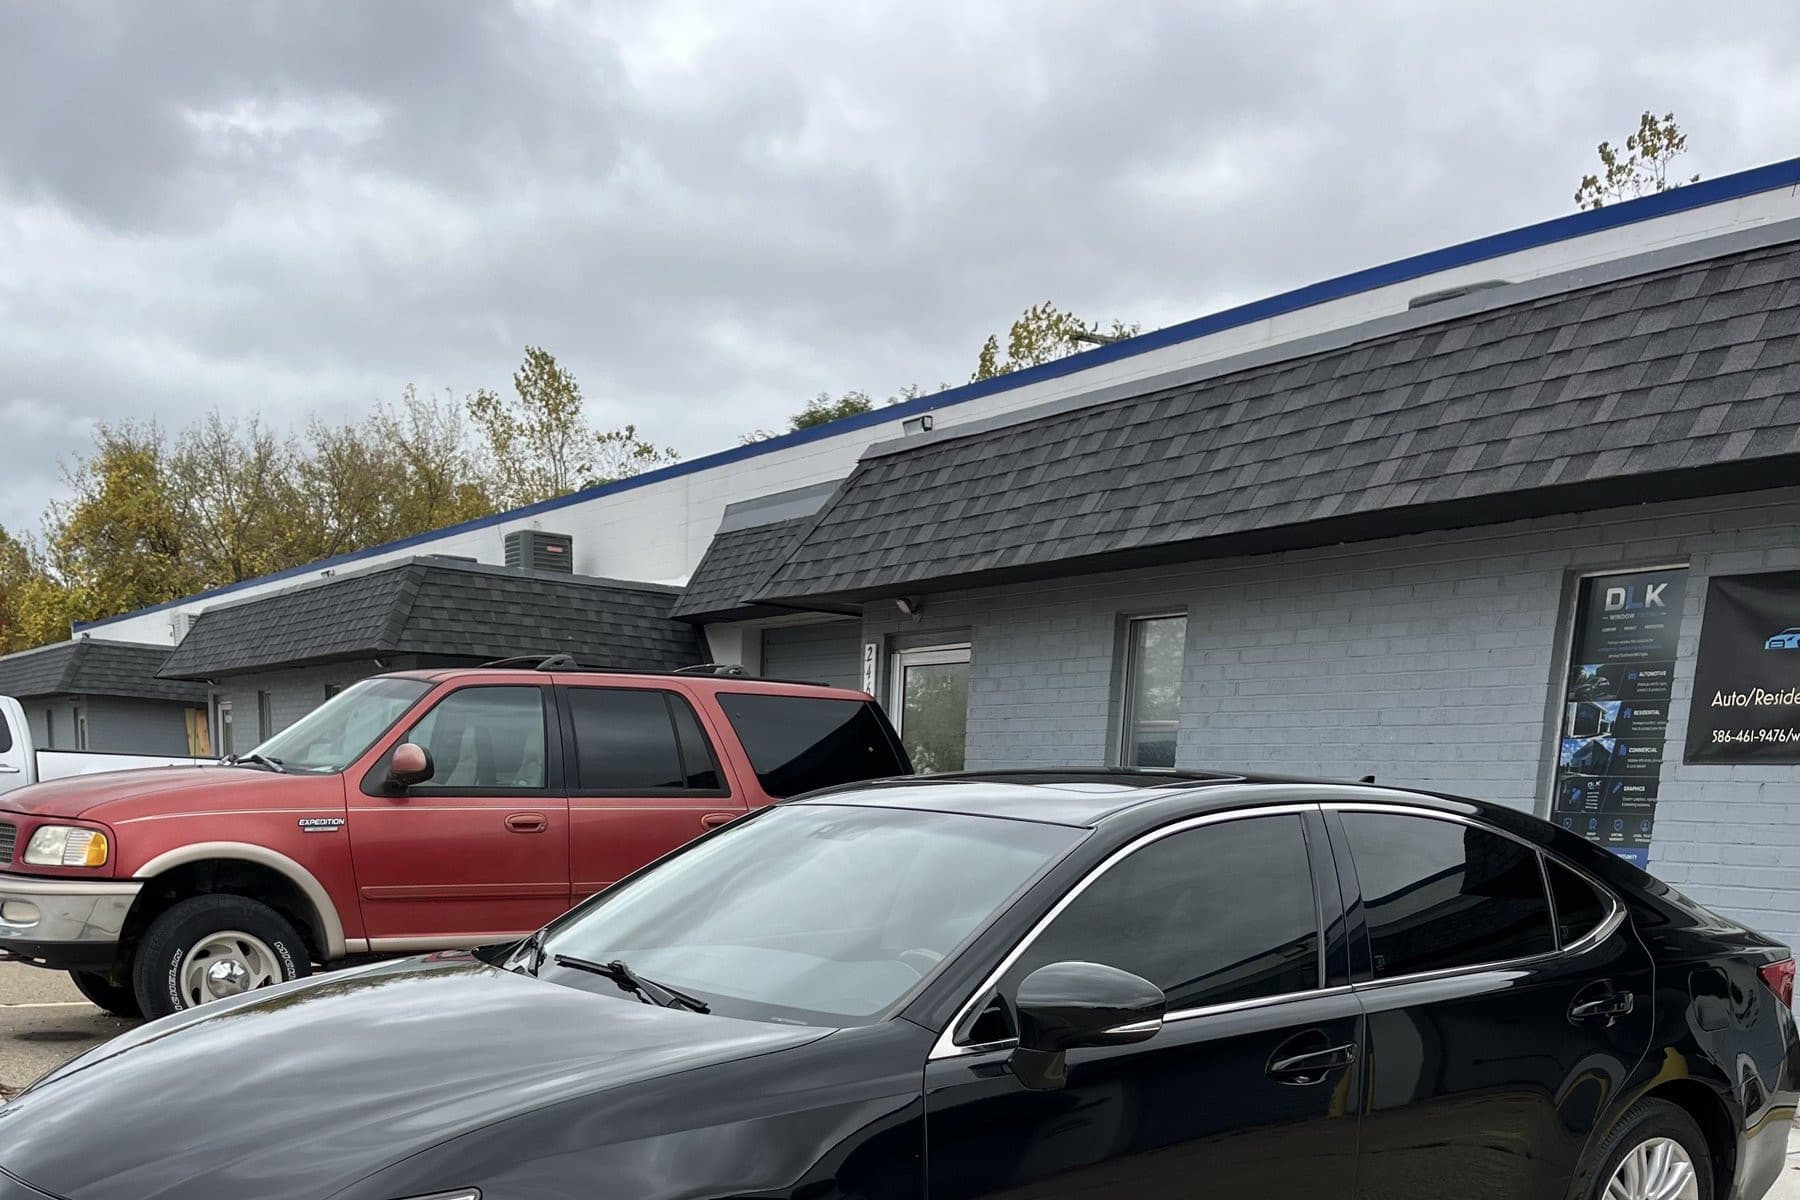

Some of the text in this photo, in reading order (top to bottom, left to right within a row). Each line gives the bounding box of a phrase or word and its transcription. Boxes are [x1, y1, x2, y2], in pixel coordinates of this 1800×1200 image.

[1604, 583, 1668, 611] DLK
[298, 818, 345, 826] EXPEDITION
[168, 948, 183, 1011] ICHELIN
